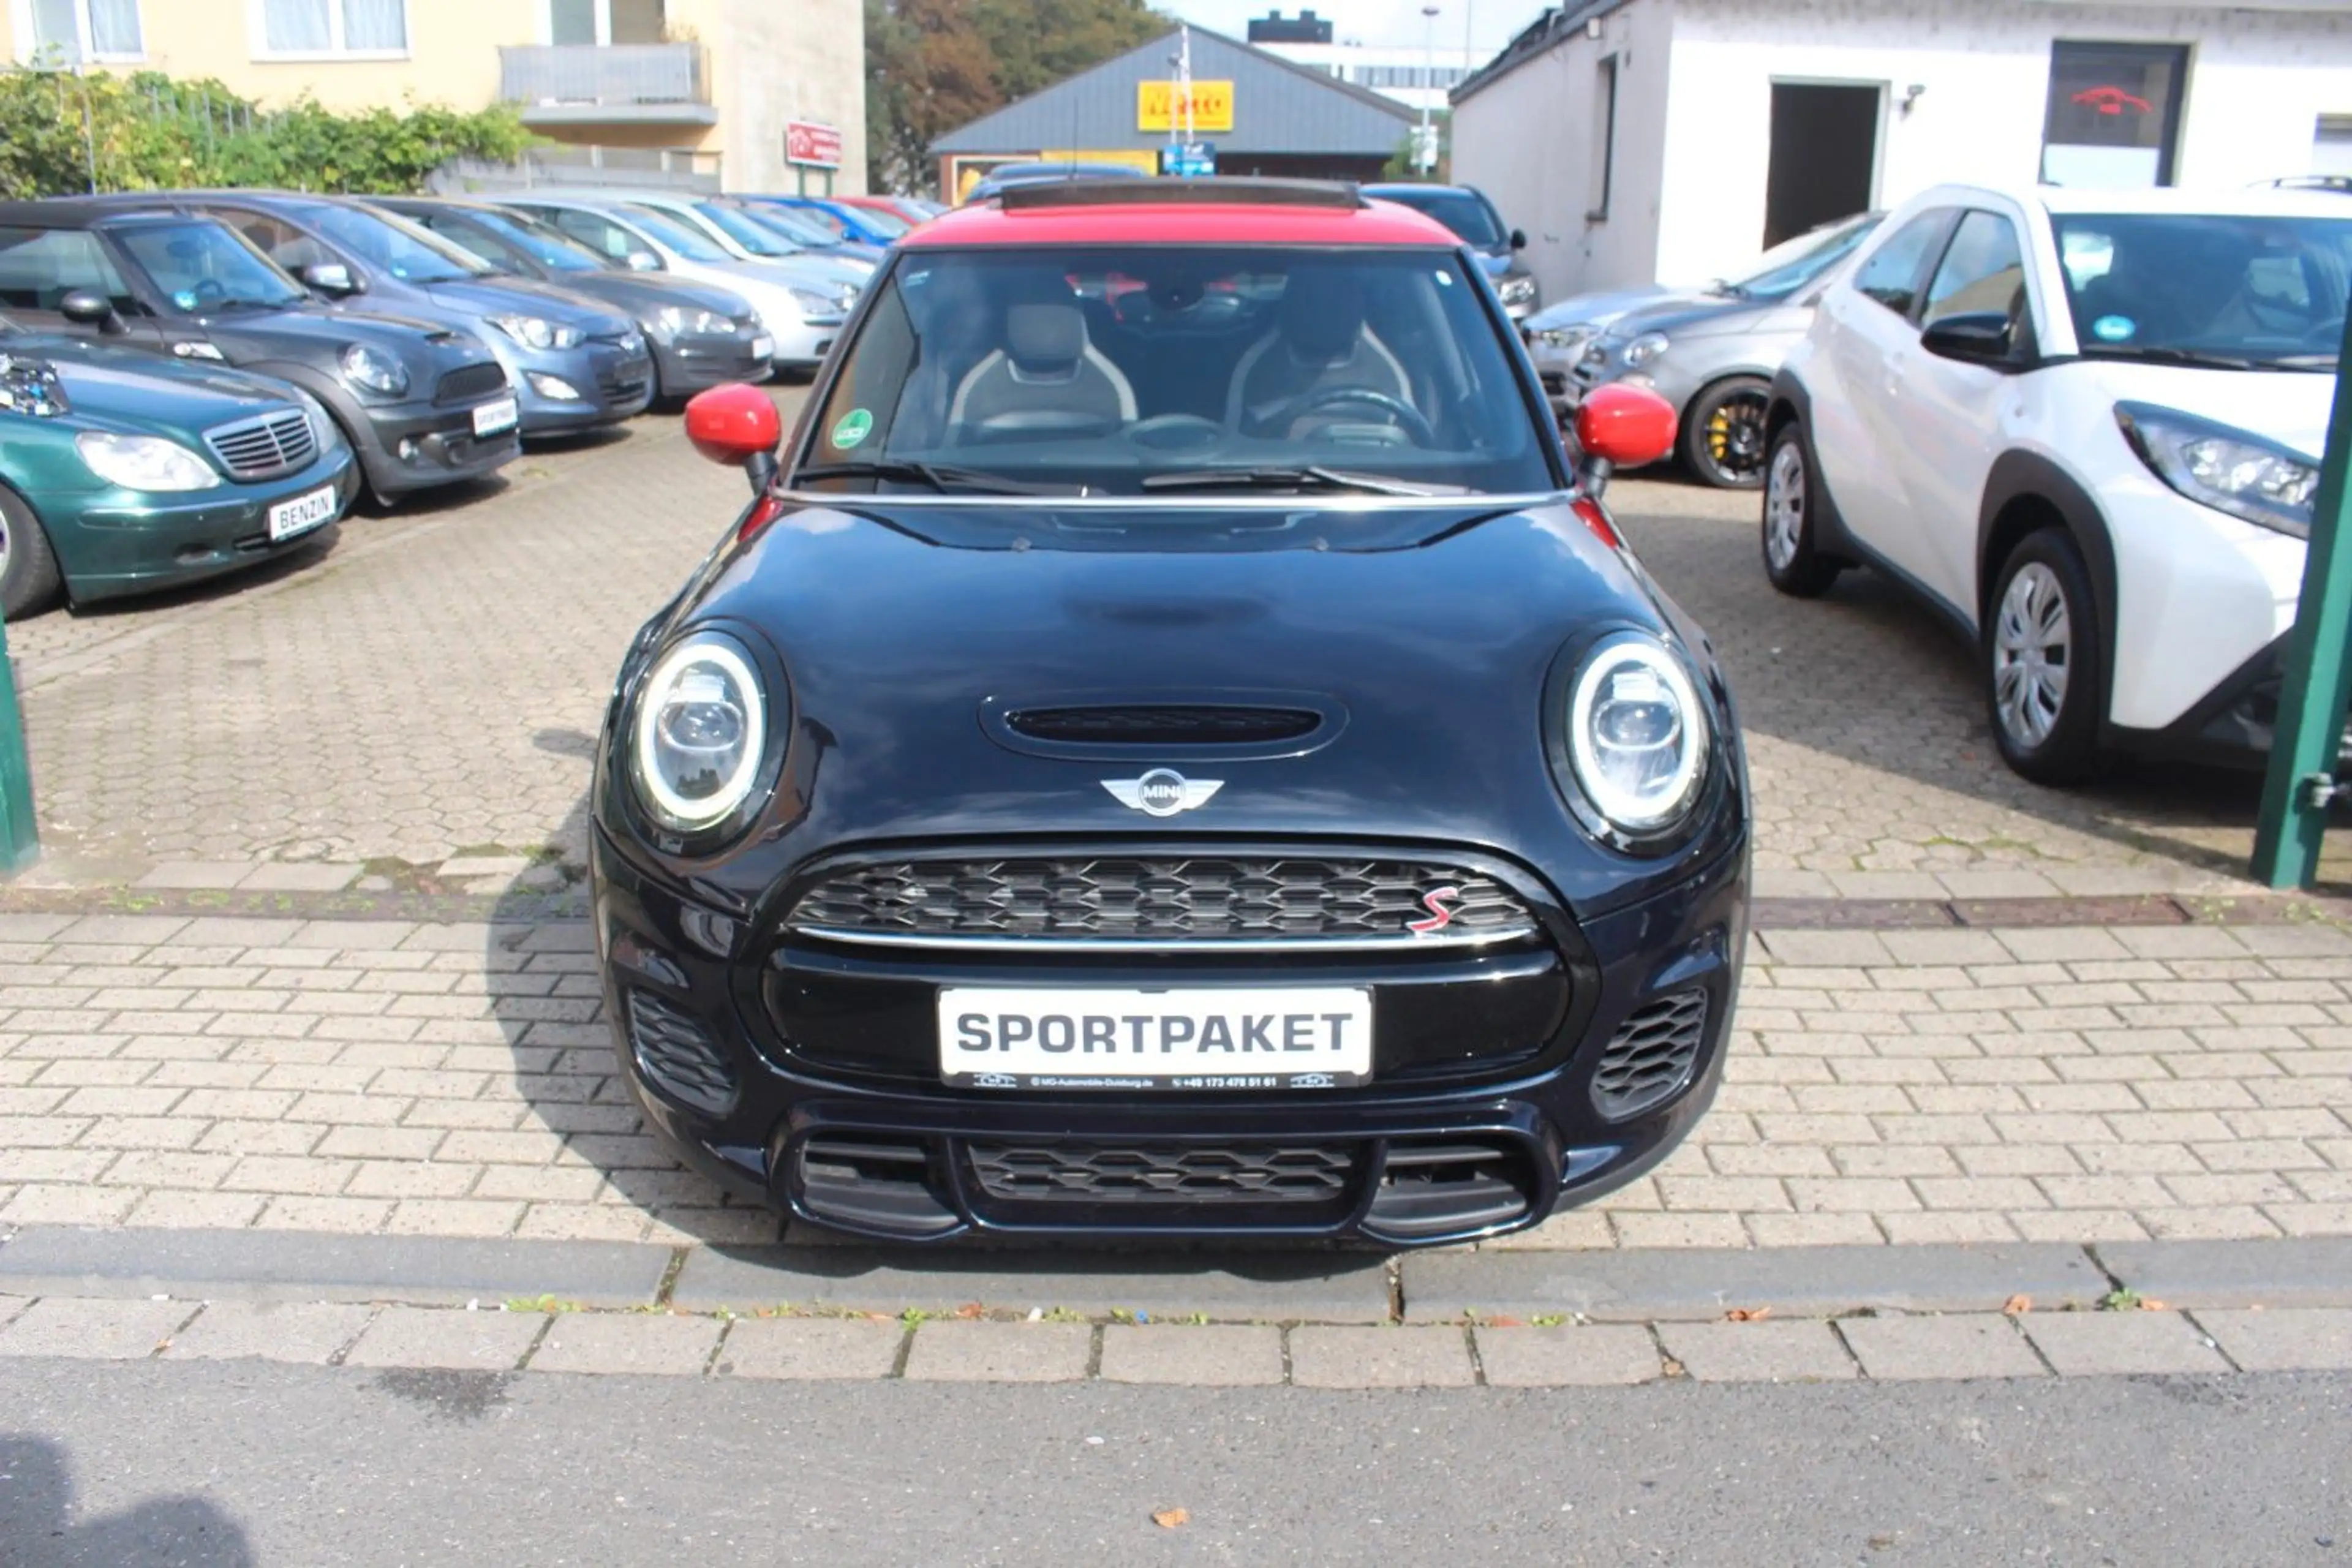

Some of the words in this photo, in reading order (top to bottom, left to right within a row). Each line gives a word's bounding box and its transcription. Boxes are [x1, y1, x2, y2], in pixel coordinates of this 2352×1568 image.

[280, 494, 329, 530] BENZIN
[1143, 785, 1182, 799] MINI
[1405, 886, 1458, 932] S
[957, 1012, 1353, 1054] SPORTPAKET
[1205, 1077, 1224, 1087] 173
